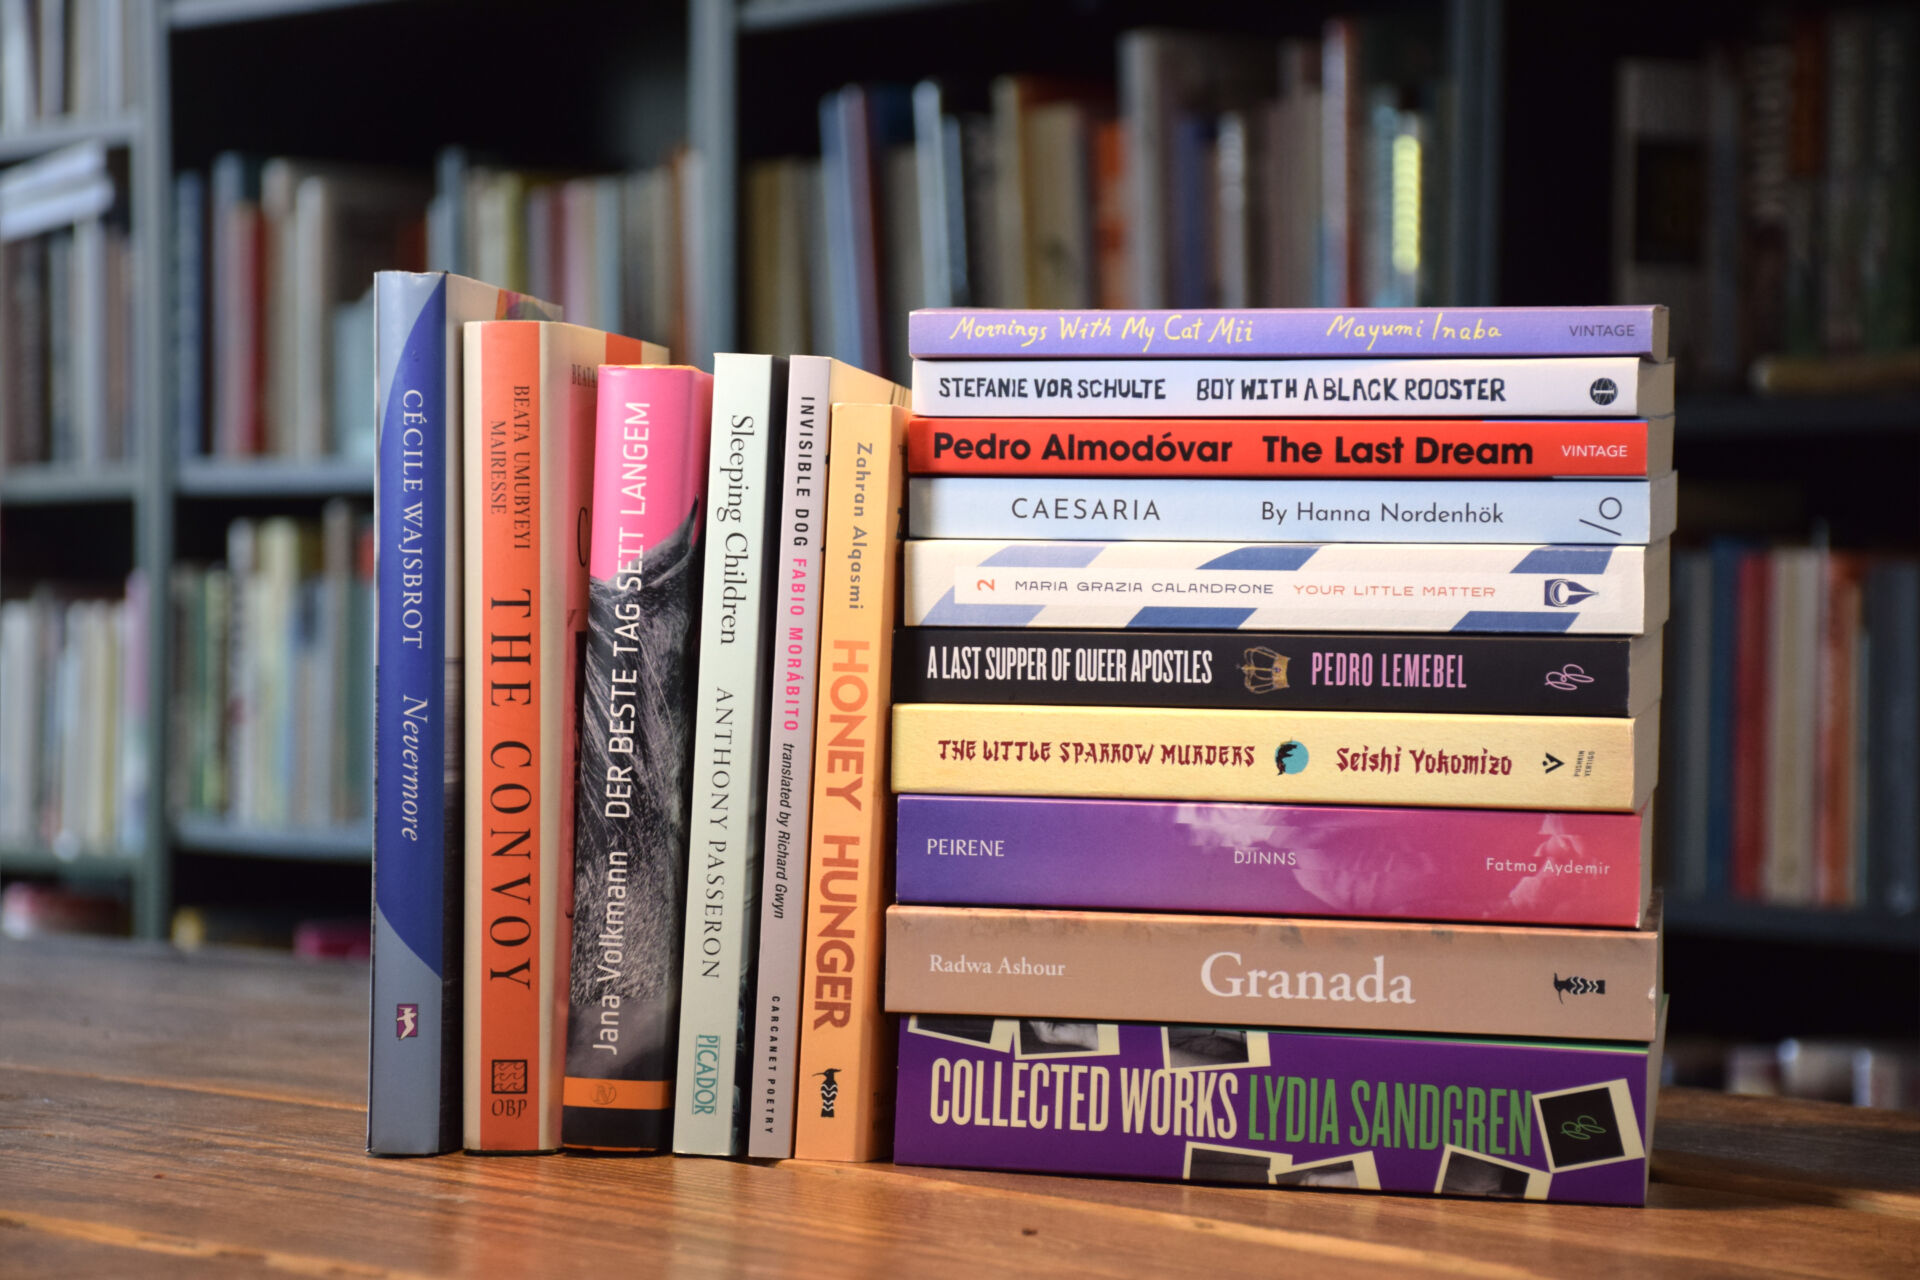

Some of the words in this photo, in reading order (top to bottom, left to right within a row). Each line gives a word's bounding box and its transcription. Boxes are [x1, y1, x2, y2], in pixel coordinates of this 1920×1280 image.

[950, 317, 1047, 347] Mornings
[1059, 316, 1111, 339] With
[1121, 316, 1154, 352] My
[1164, 314, 1204, 340] Cat
[1208, 316, 1254, 343] Mii
[1326, 314, 1424, 350] Mayumi
[1432, 312, 1502, 340] Inaba
[1569, 324, 1635, 337] VINTAGE
[513, 385, 530, 447] BEATA
[939, 377, 1028, 398] STEFANIE
[1034, 378, 1073, 398] VOR
[1077, 378, 1166, 399] SCHULTE
[1196, 378, 1235, 400] BOY
[1241, 378, 1297, 400] WITH
[1303, 378, 1319, 399] A
[1323, 378, 1400, 401] BLACK
[1405, 377, 1506, 401] ROOSTER
[402, 389, 428, 493] CÉCILE
[490, 420, 507, 515] MAIRESSE
[620, 402, 650, 515] LANGEM
[716, 415, 755, 523] Sleeping
[795, 396, 815, 497] INVISIBLE
[933, 432, 1031, 460] Pedro
[1041, 432, 1232, 462] Almodóvar
[1262, 435, 1322, 463] The
[1335, 436, 1404, 464] Last
[1416, 436, 1533, 465] Dream
[1561, 444, 1628, 457] VINTAGE
[513, 451, 531, 550] UMUBYEYI
[852, 442, 872, 517] Zahran
[793, 507, 810, 547] DOG
[1011, 498, 1160, 521] CAESARIA
[1261, 501, 1288, 525] By
[1297, 502, 1370, 522] Hanna
[1381, 503, 1504, 523] Nordenhök
[398, 501, 423, 650] WAJSBROT
[616, 527, 645, 592] SEIT
[720, 532, 749, 645] Children
[789, 558, 807, 616] FABIO
[847, 525, 867, 610] Alqasmi
[1015, 581, 1068, 592] MARIA
[1077, 582, 1143, 593] GRAZIA
[1152, 583, 1274, 594] CALANDRONE
[1293, 584, 1345, 596] YOUR
[1353, 585, 1414, 597] LITTLE
[1423, 586, 1496, 597] MATTER
[490, 588, 532, 707] THE
[612, 599, 641, 656] TAG
[783, 627, 803, 731] MORÁBITO
[927, 646, 938, 679] A
[942, 646, 982, 680] LAST
[985, 647, 1047, 681] SUPPER
[1050, 648, 1071, 681] OF
[1075, 648, 1126, 683] QUEER
[1130, 649, 1213, 684] APOSTLES
[1312, 652, 1373, 687] PEDRO
[1381, 654, 1467, 688] LEMEBEL
[609, 668, 638, 755] BESTE
[824, 639, 870, 811] HONEY
[401, 694, 429, 842] Nevermore
[709, 687, 734, 830] ANTHONY
[777, 743, 795, 809] translated
[937, 739, 977, 761] THE
[983, 741, 1051, 762] LITTLE
[1059, 742, 1154, 764] SPARROW
[1160, 744, 1256, 768] MURDERS
[1336, 745, 1402, 775] Seishi
[1409, 747, 1513, 777] Yokomizo
[1574, 750, 1585, 777] PUSHKIN
[1584, 751, 1595, 777] VERTIGO
[605, 765, 633, 819] DER
[776, 812, 791, 828] by
[489, 740, 532, 990] CONVOY
[775, 831, 791, 880] Richard
[927, 838, 1005, 857] PEIRENE
[1234, 850, 1296, 866] DJINNS
[1486, 857, 1537, 873] Fatma
[1544, 859, 1610, 876] Aydemir
[597, 850, 628, 981] Volkmann
[701, 840, 727, 979] PASSERON
[771, 883, 787, 919] Gwyn
[813, 834, 860, 1031] HUNGER
[929, 954, 992, 974] Radwa
[996, 955, 1066, 977] Ashour
[1201, 952, 1416, 1004] Granada
[592, 994, 620, 1056] Jana
[767, 996, 781, 1072] CARCANET
[691, 1034, 720, 1115] PICADOR
[764, 1078, 776, 1135] POETRY
[930, 1057, 1110, 1132] COLLECTED
[1120, 1067, 1239, 1140] WORKS
[1248, 1074, 1340, 1145] LYDIA
[1350, 1079, 1532, 1157] SANDGREN
